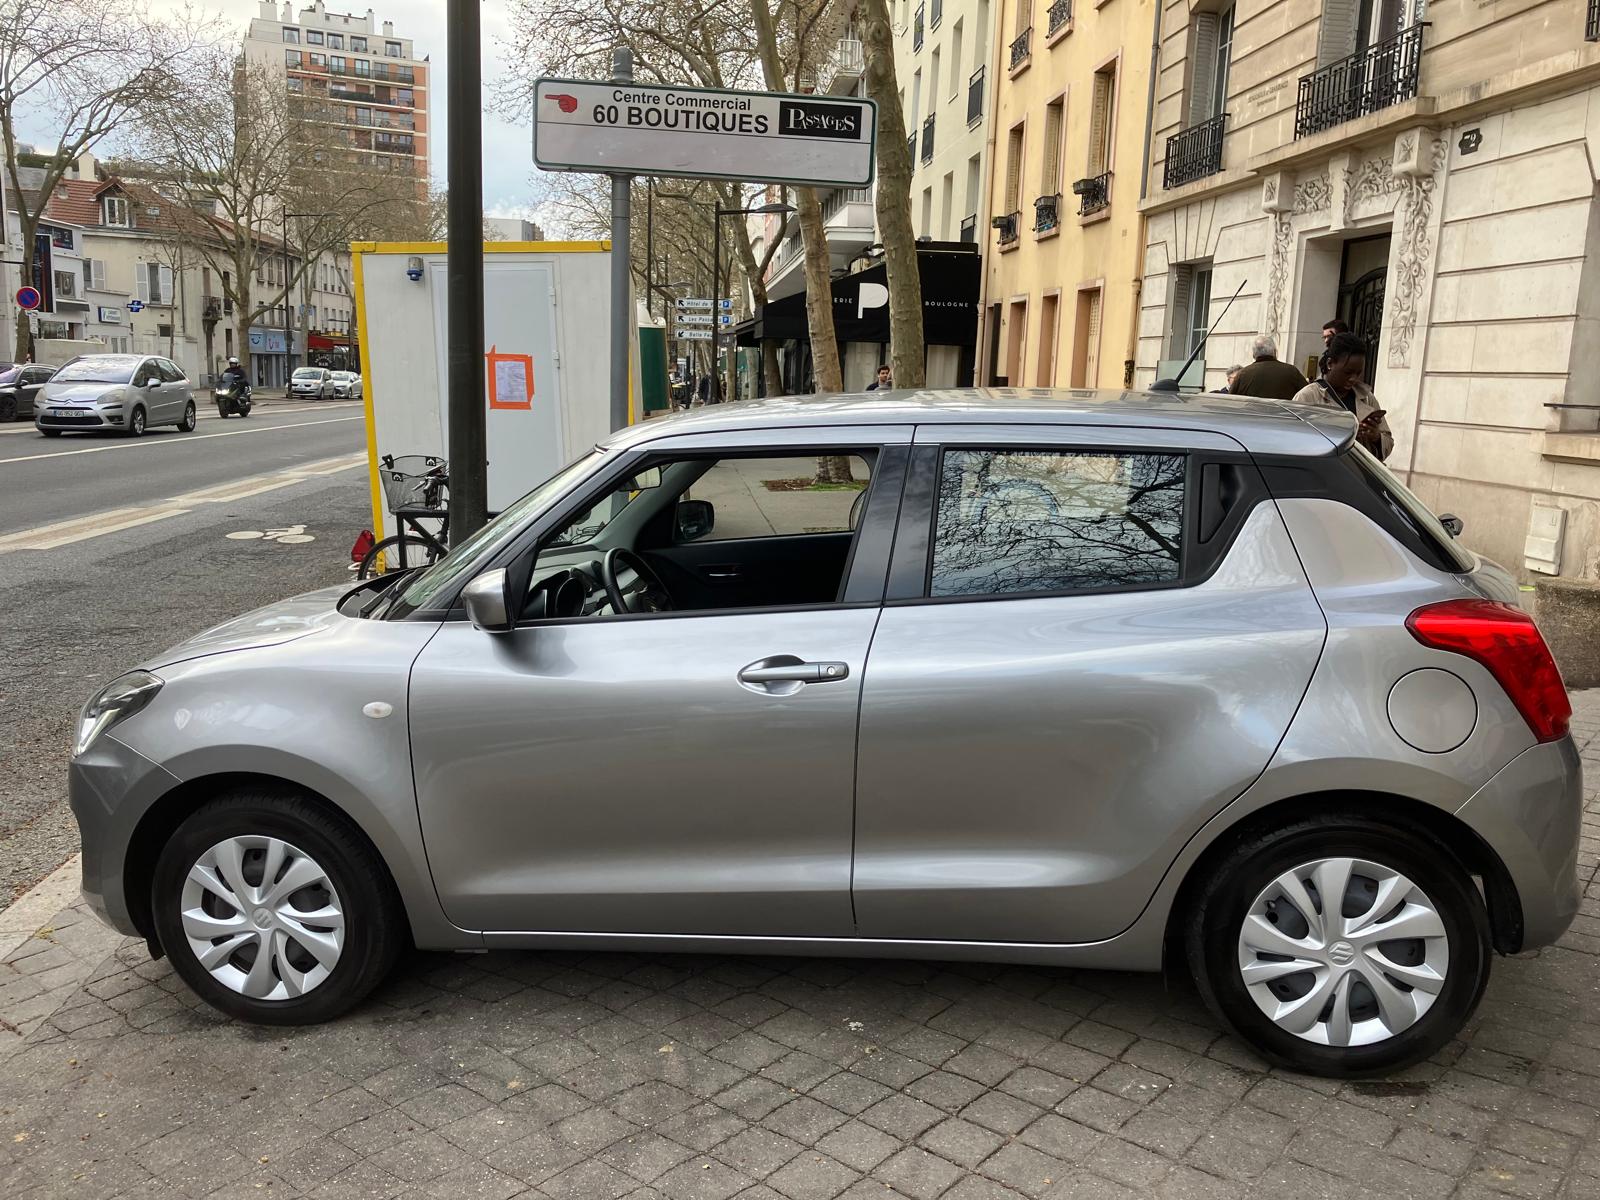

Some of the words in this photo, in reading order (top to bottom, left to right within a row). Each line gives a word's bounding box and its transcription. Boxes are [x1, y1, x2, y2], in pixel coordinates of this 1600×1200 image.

[612, 89, 661, 105] Centre
[665, 93, 751, 111] Commercial
[592, 104, 619, 125] 60
[627, 108, 769, 134] BOUTIQUES
[786, 107, 856, 132] PASSAGES
[857, 282, 889, 319] P
[925, 300, 969, 308] BOULOGNE
